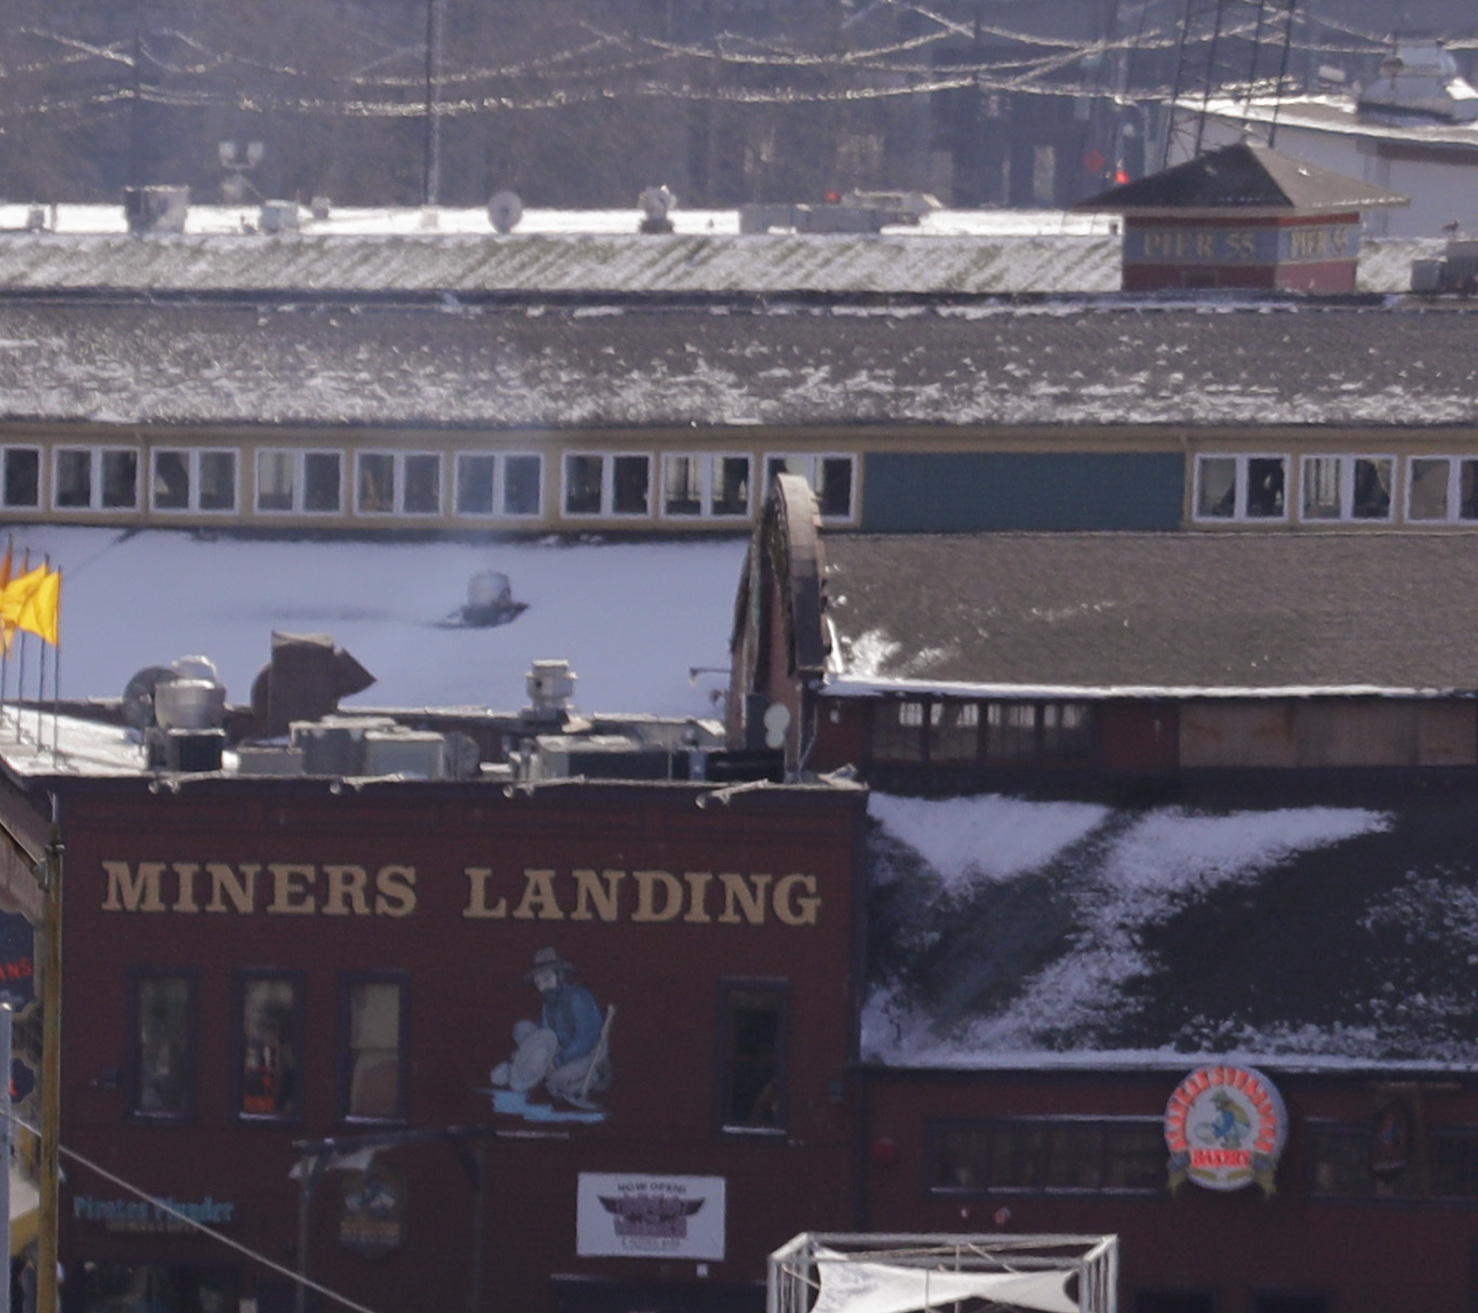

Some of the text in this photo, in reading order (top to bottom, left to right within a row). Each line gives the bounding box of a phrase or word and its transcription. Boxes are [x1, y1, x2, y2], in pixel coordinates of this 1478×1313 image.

[1143, 232, 1255, 259] PIER 55
[1289, 231, 1327, 256] PIER
[101, 859, 822, 928] MINERS LANDING
